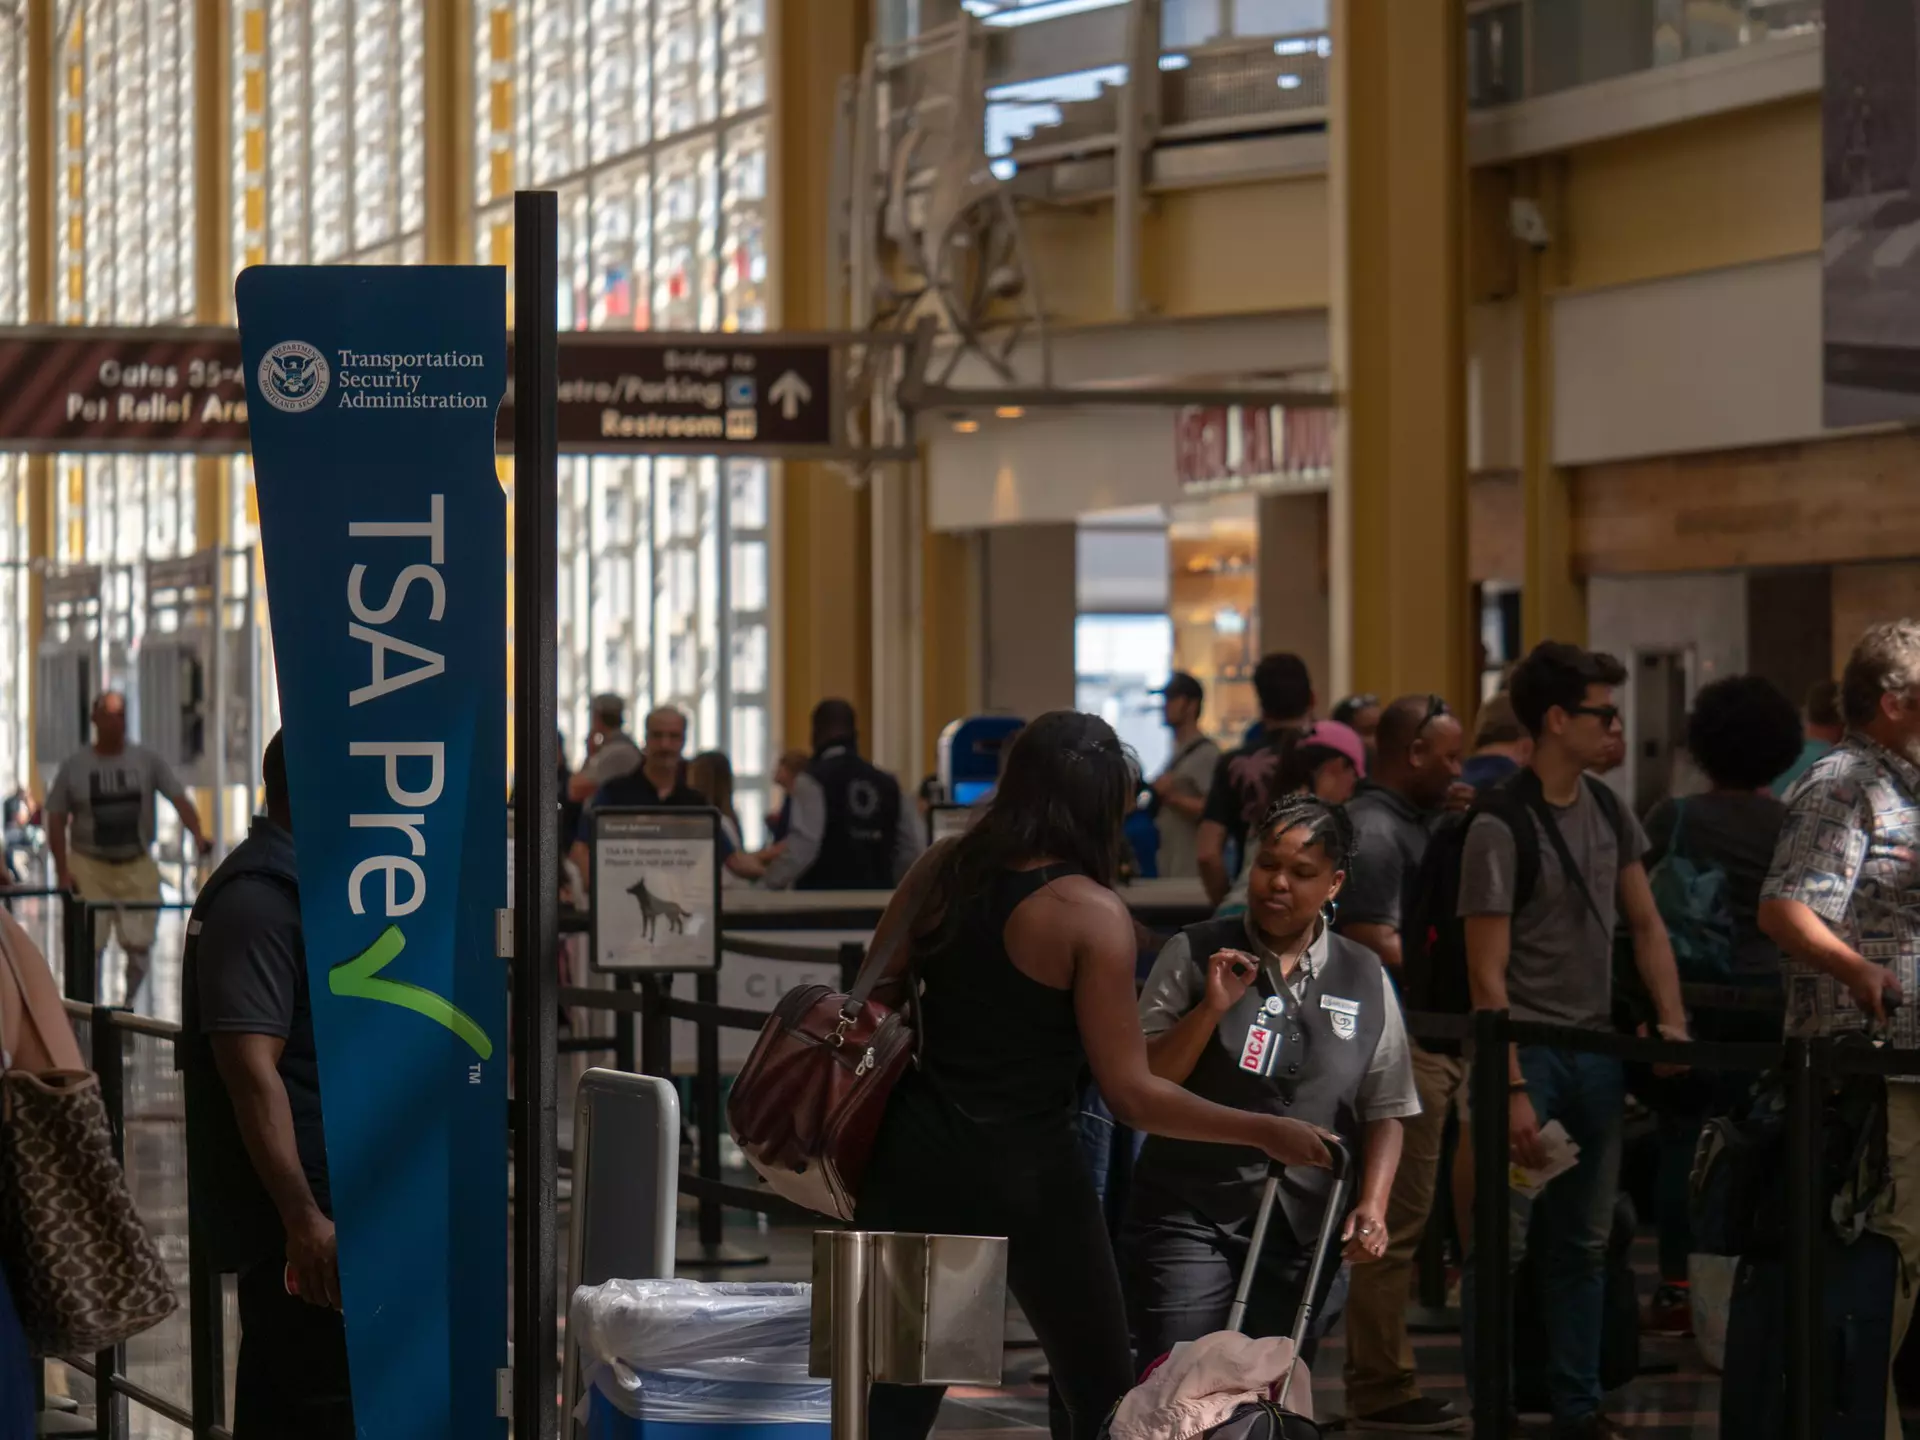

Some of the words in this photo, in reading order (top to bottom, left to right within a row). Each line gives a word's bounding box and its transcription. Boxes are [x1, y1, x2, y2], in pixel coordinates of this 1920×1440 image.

[273, 343, 320, 361] DEPARTMENT
[338, 350, 484, 372] Transportation
[99, 359, 178, 387] Gates
[339, 371, 421, 392] Security
[66, 393, 107, 421] Pet
[117, 391, 192, 422] Relief
[201, 394, 248, 422] Are
[261, 380, 295, 409] HOMELAND
[299, 380, 326, 409] SECURITY
[338, 390, 488, 408] Administration
[558, 375, 722, 409] etro/Parking
[602, 408, 723, 438] Restroom
[347, 494, 446, 707] TSA
[347, 741, 446, 916] Pre
[1243, 1029, 1267, 1070] DCA
[469, 1062, 481, 1084] TM
